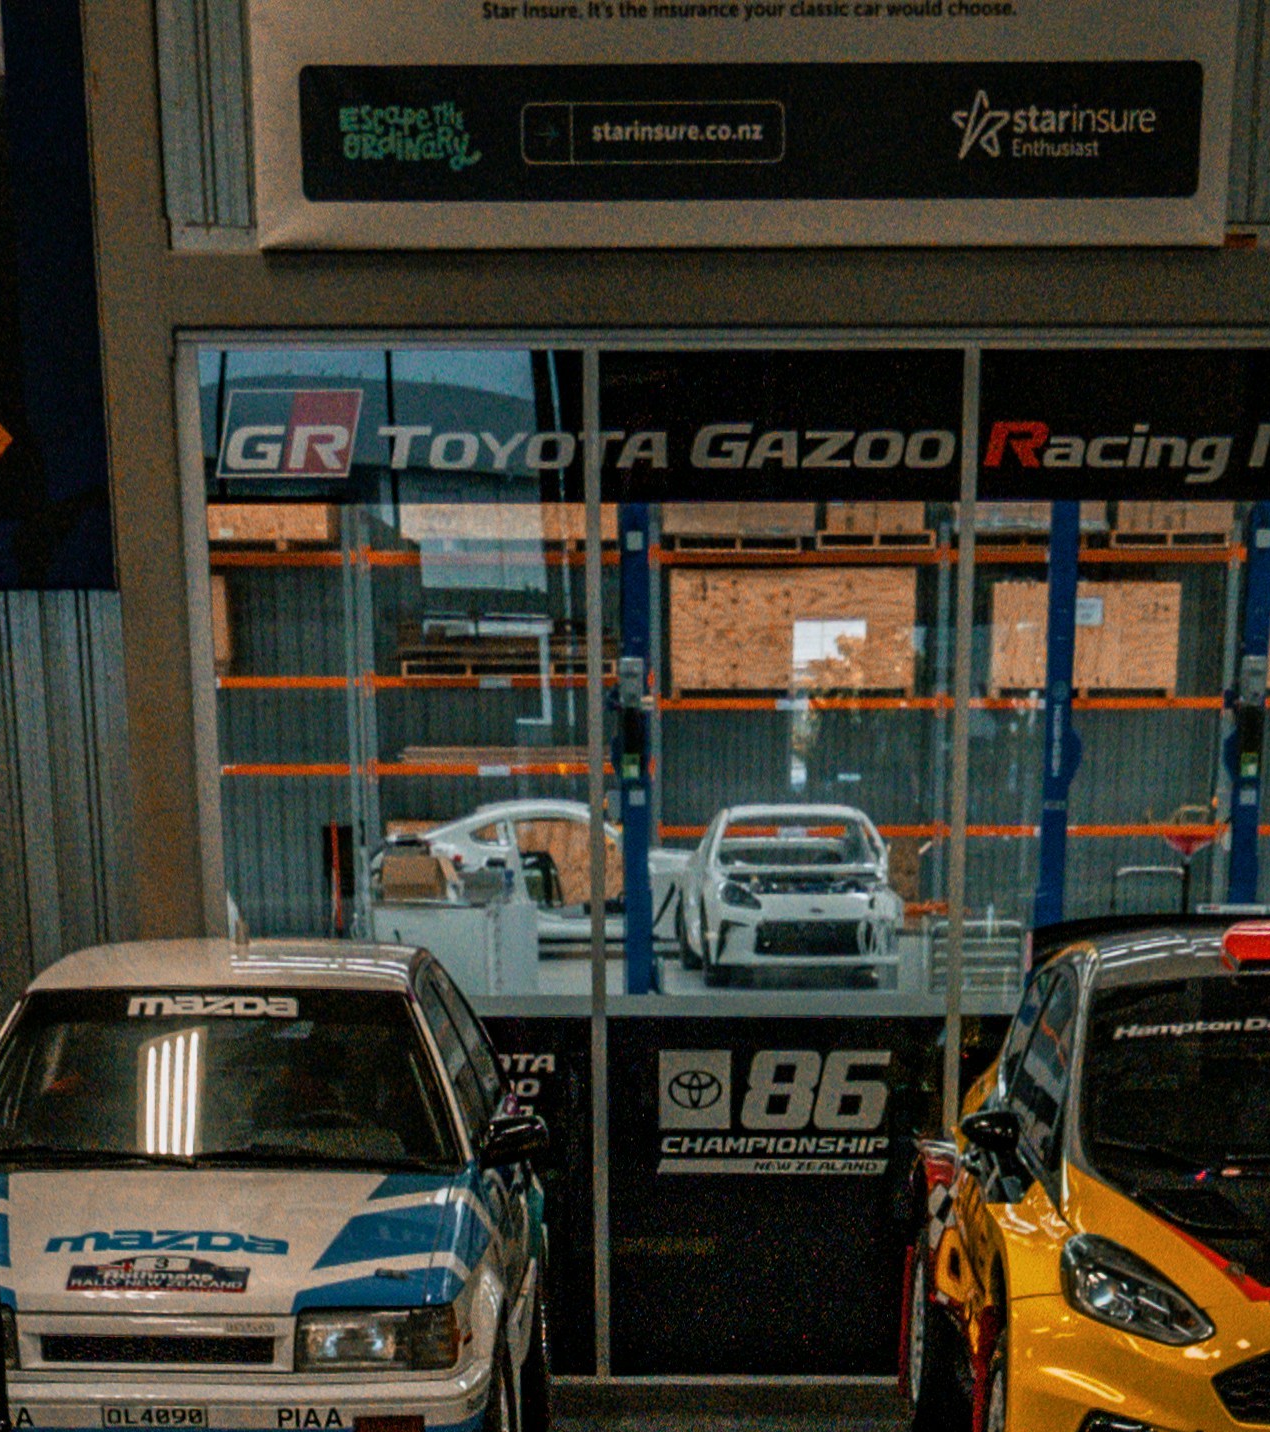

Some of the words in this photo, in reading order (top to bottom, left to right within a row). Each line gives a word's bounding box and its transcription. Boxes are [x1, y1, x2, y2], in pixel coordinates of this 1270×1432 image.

[592, 121, 764, 142] starinsure.co.nz
[1012, 138, 1100, 158] Enthusiast
[225, 425, 351, 472] GR
[377, 424, 668, 471] TOYOTA
[689, 423, 956, 469] GAZOO
[983, 421, 1234, 484] Racing
[127, 995, 299, 1019] mazda
[1113, 1018, 1241, 1040] Hampton
[740, 1049, 892, 1131] 86
[661, 1135, 890, 1155] CHAMPIONSHIP
[754, 1160, 793, 1171] NEW
[796, 1160, 877, 1171] ZEALAND
[45, 1230, 289, 1256] mazda
[70, 1278, 121, 1287] RALLY
[124, 1278, 161, 1288] NEW
[165, 1279, 244, 1289] ZEALAND
[102, 1269, 214, 1281] Rothmans
[107, 1408, 203, 1426] OL4090
[277, 1408, 343, 1428] PIAA
